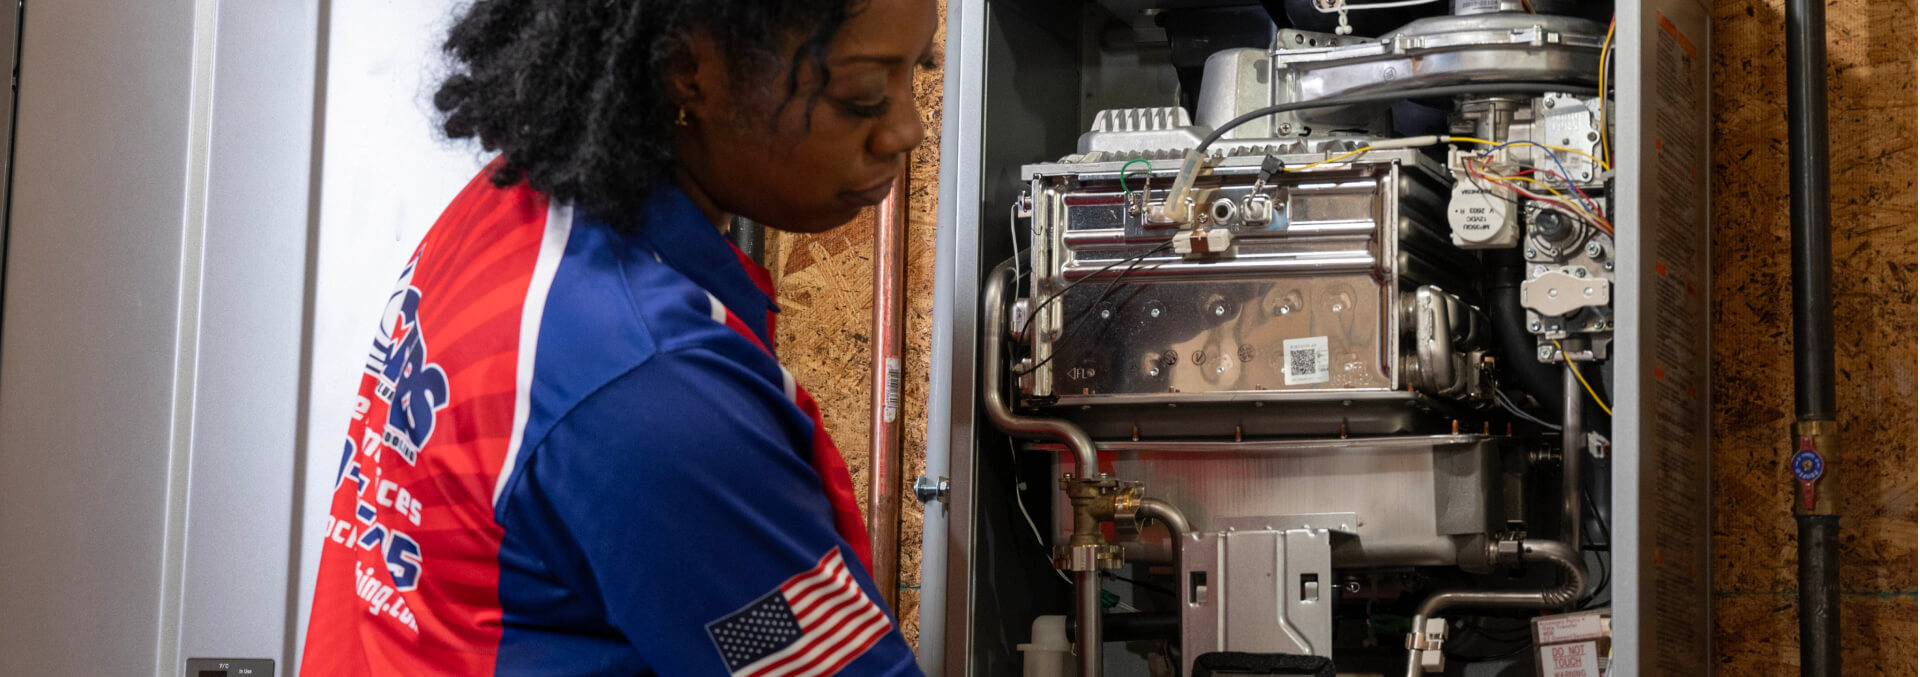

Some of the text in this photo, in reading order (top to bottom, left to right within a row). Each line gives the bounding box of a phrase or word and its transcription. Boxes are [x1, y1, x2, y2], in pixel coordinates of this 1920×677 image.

[1552, 645, 1585, 657] DO NOT
[1554, 656, 1582, 669] TOUCH
